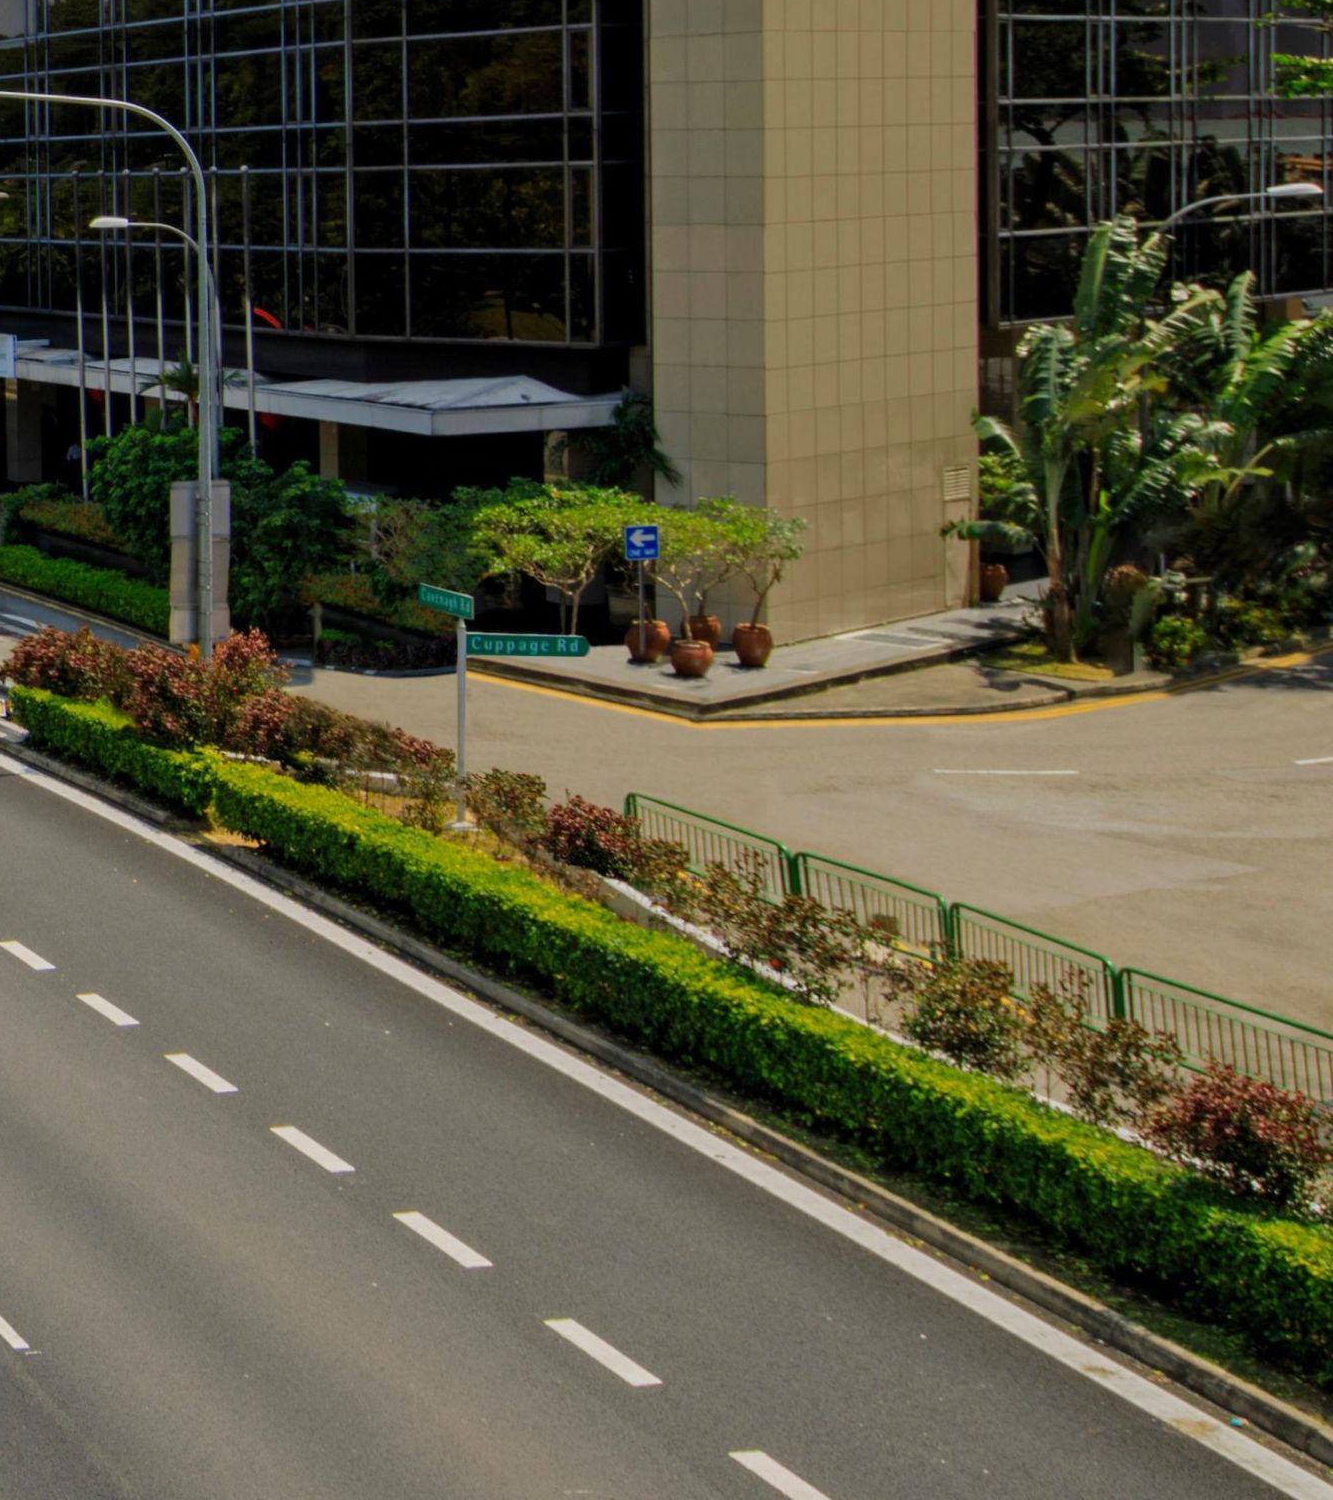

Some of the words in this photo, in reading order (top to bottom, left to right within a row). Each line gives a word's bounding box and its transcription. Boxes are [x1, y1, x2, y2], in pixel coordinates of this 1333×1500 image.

[420, 586, 458, 612] Cavenagh
[459, 596, 470, 614] Rd
[471, 636, 549, 654] Cuppage
[557, 638, 579, 652] Rd
